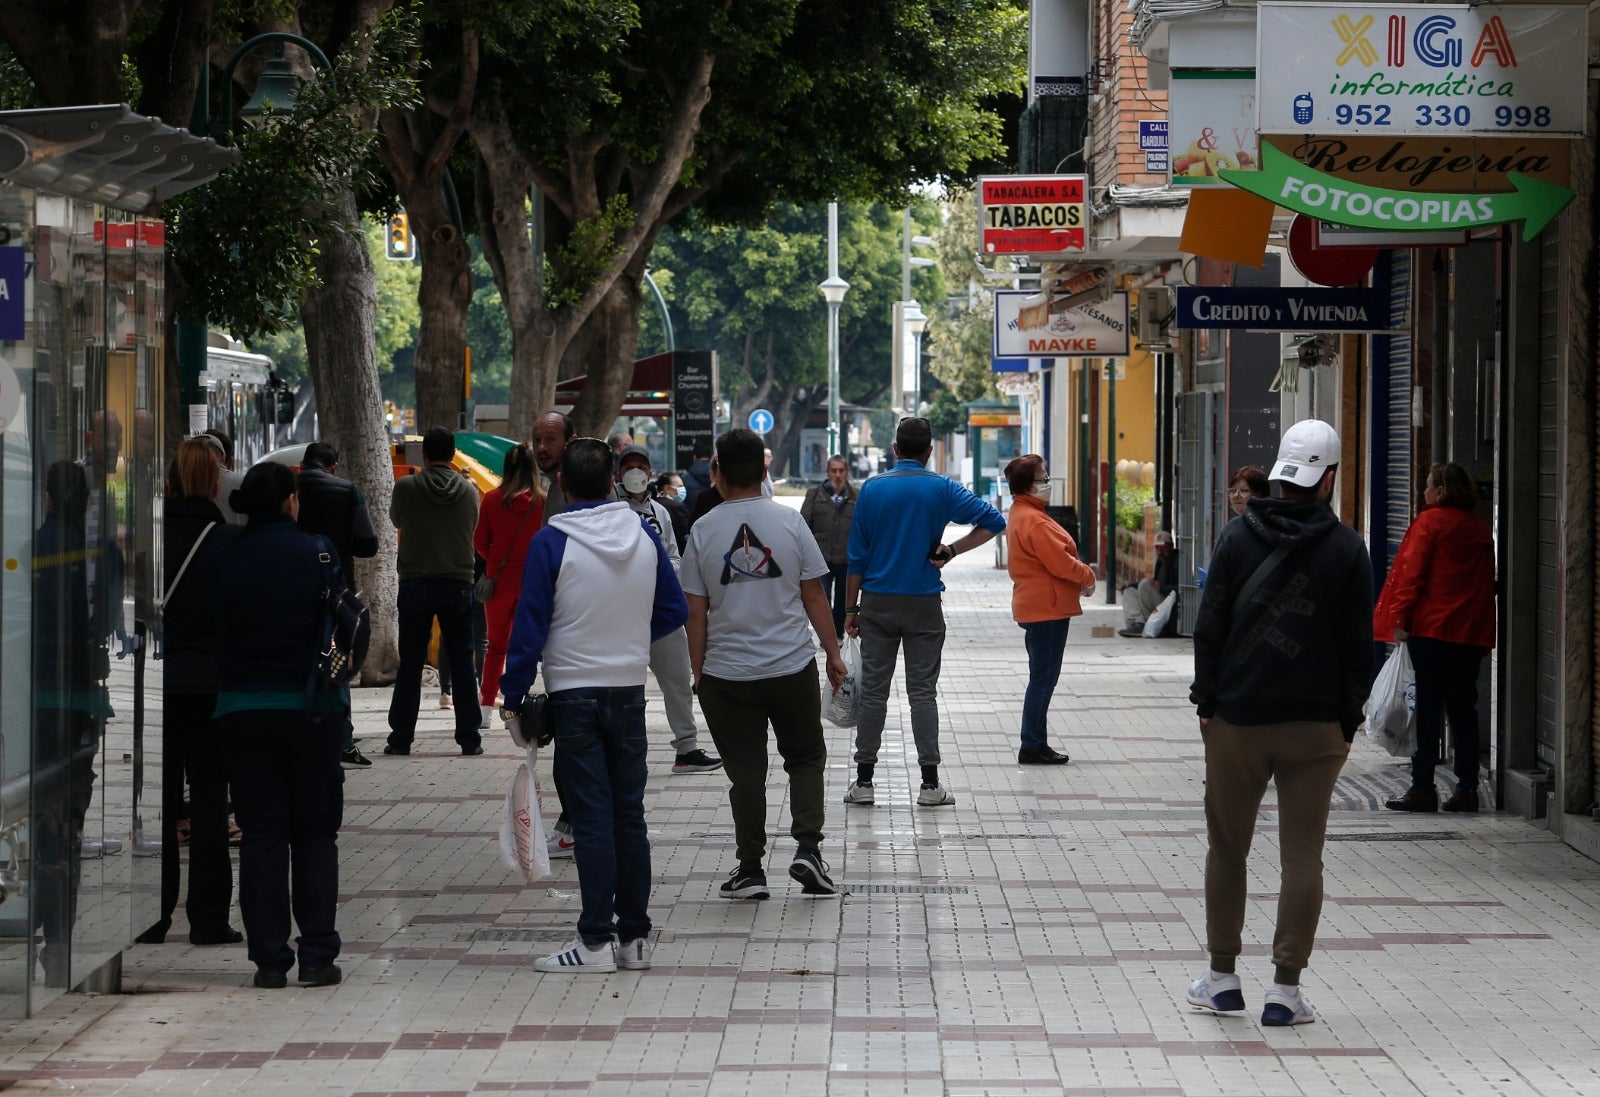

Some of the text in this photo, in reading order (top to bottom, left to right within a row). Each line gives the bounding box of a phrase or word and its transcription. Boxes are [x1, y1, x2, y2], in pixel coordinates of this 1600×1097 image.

[1331, 14, 1518, 68] XIGA
[1329, 71, 1514, 97] informática
[1150, 123, 1168, 131] CALL
[1335, 104, 1551, 127] 952 330 998
[1142, 135, 1168, 147] BARQUILL
[1293, 139, 1551, 187] Relojería
[987, 186, 1055, 199] TABACALERA
[1280, 176, 1493, 223] FOTOCOPIAS
[988, 205, 1080, 228] TABACOS
[1077, 303, 1124, 332] TESANOS
[1192, 295, 1271, 321] CREDITO
[1287, 298, 1368, 322] VIVIENDA
[1028, 338, 1097, 352] MAYKE
[686, 366, 699, 374] Bar
